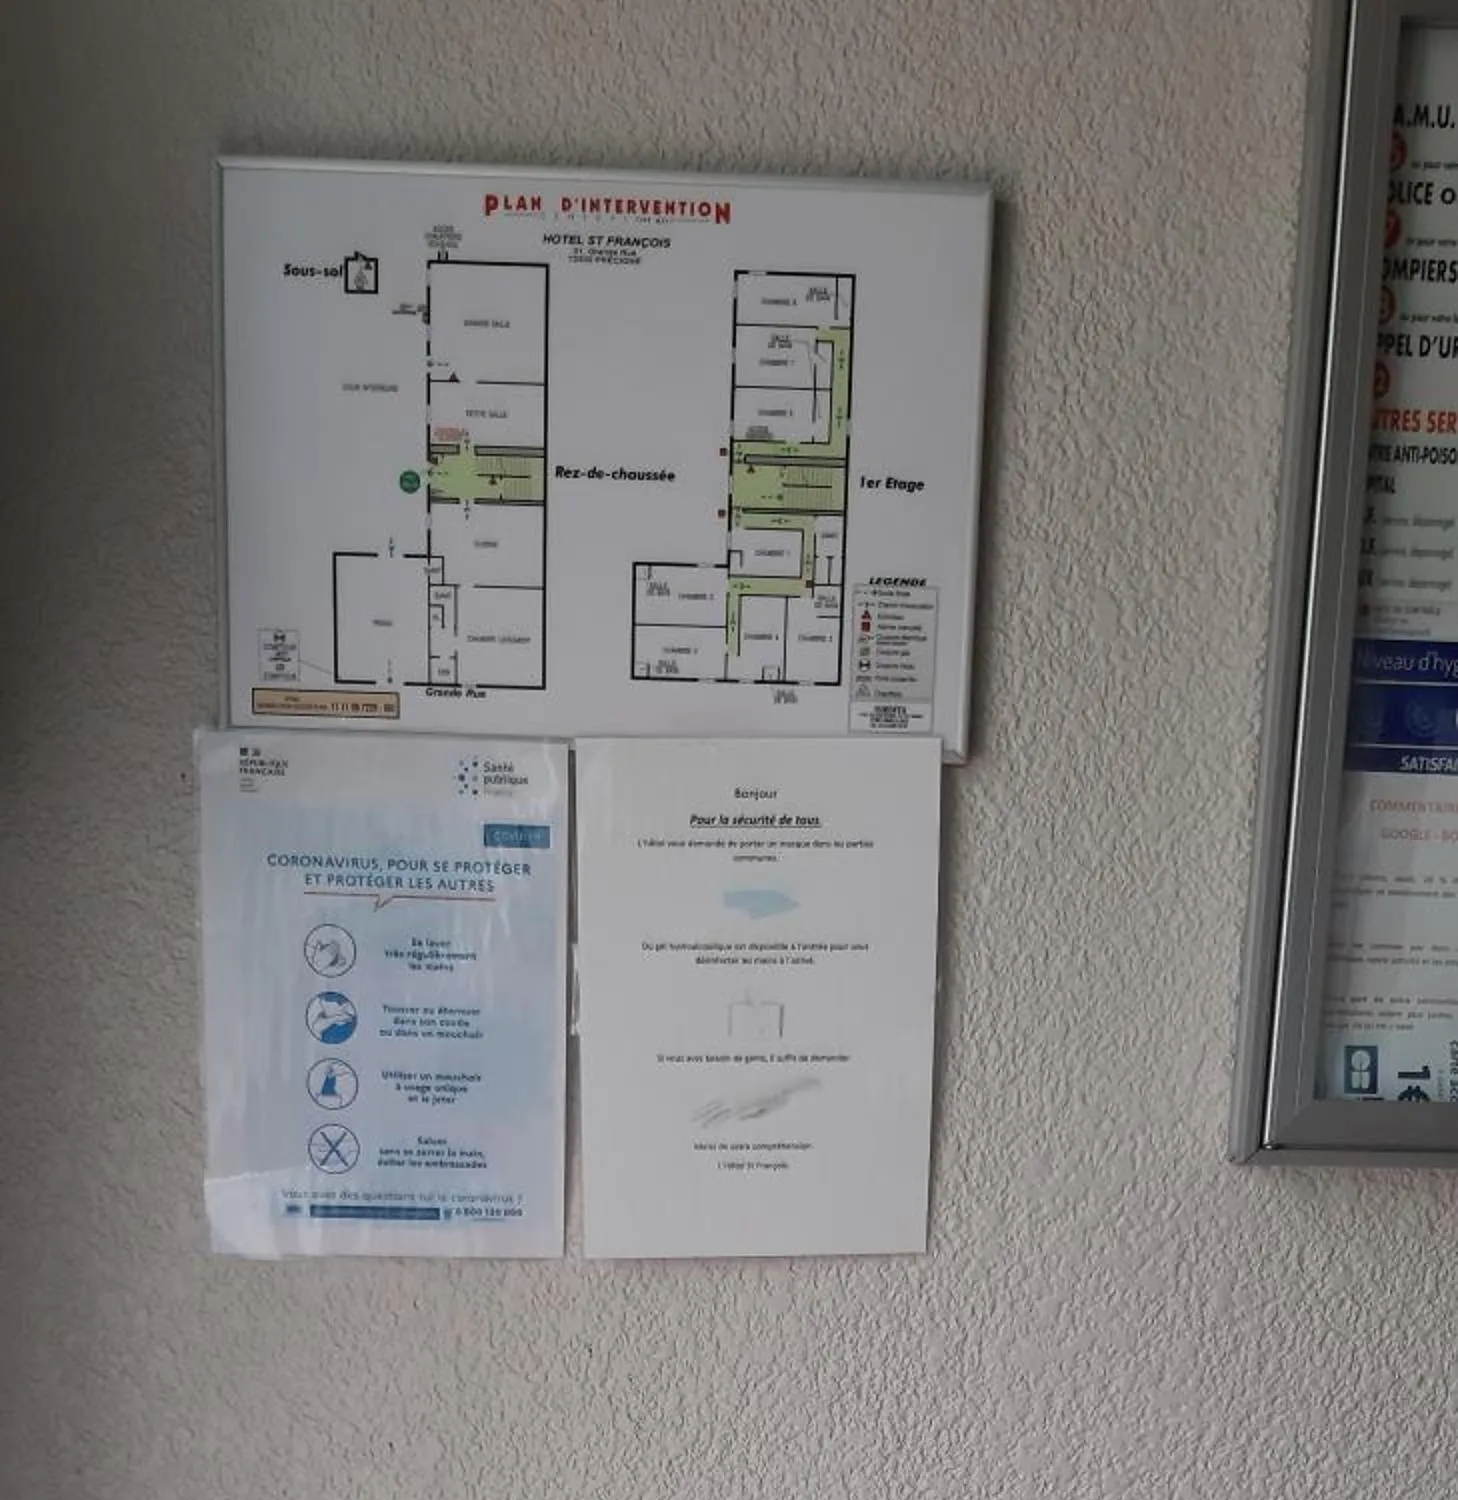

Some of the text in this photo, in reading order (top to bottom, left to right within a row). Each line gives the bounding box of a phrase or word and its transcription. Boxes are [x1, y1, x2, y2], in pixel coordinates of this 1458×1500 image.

[485, 194, 542, 216] PLAN
[561, 196, 731, 224] D'INTERVENTION
[543, 233, 672, 249] HOTEL ST FRANÇOIS
[284, 263, 344, 277] Sous-sol
[555, 465, 677, 482] Rez-de-chaussée
[861, 475, 925, 493] 1er Etage
[868, 575, 927, 588] LEGENDE
[425, 687, 463, 698] Grande
[483, 761, 515, 773] Santé
[1400, 754, 1458, 772] SATISFA
[483, 774, 529, 786] publique
[734, 787, 778, 800] Bonjour
[689, 813, 716, 826] Pour
[719, 813, 729, 826] la
[731, 813, 775, 826] sécurité
[778, 813, 793, 826] de
[267, 853, 531, 876] CORONAVIRUS, POUR SE PROTÉGER
[305, 873, 495, 893] ET PROTÉGER LES AUTRES
